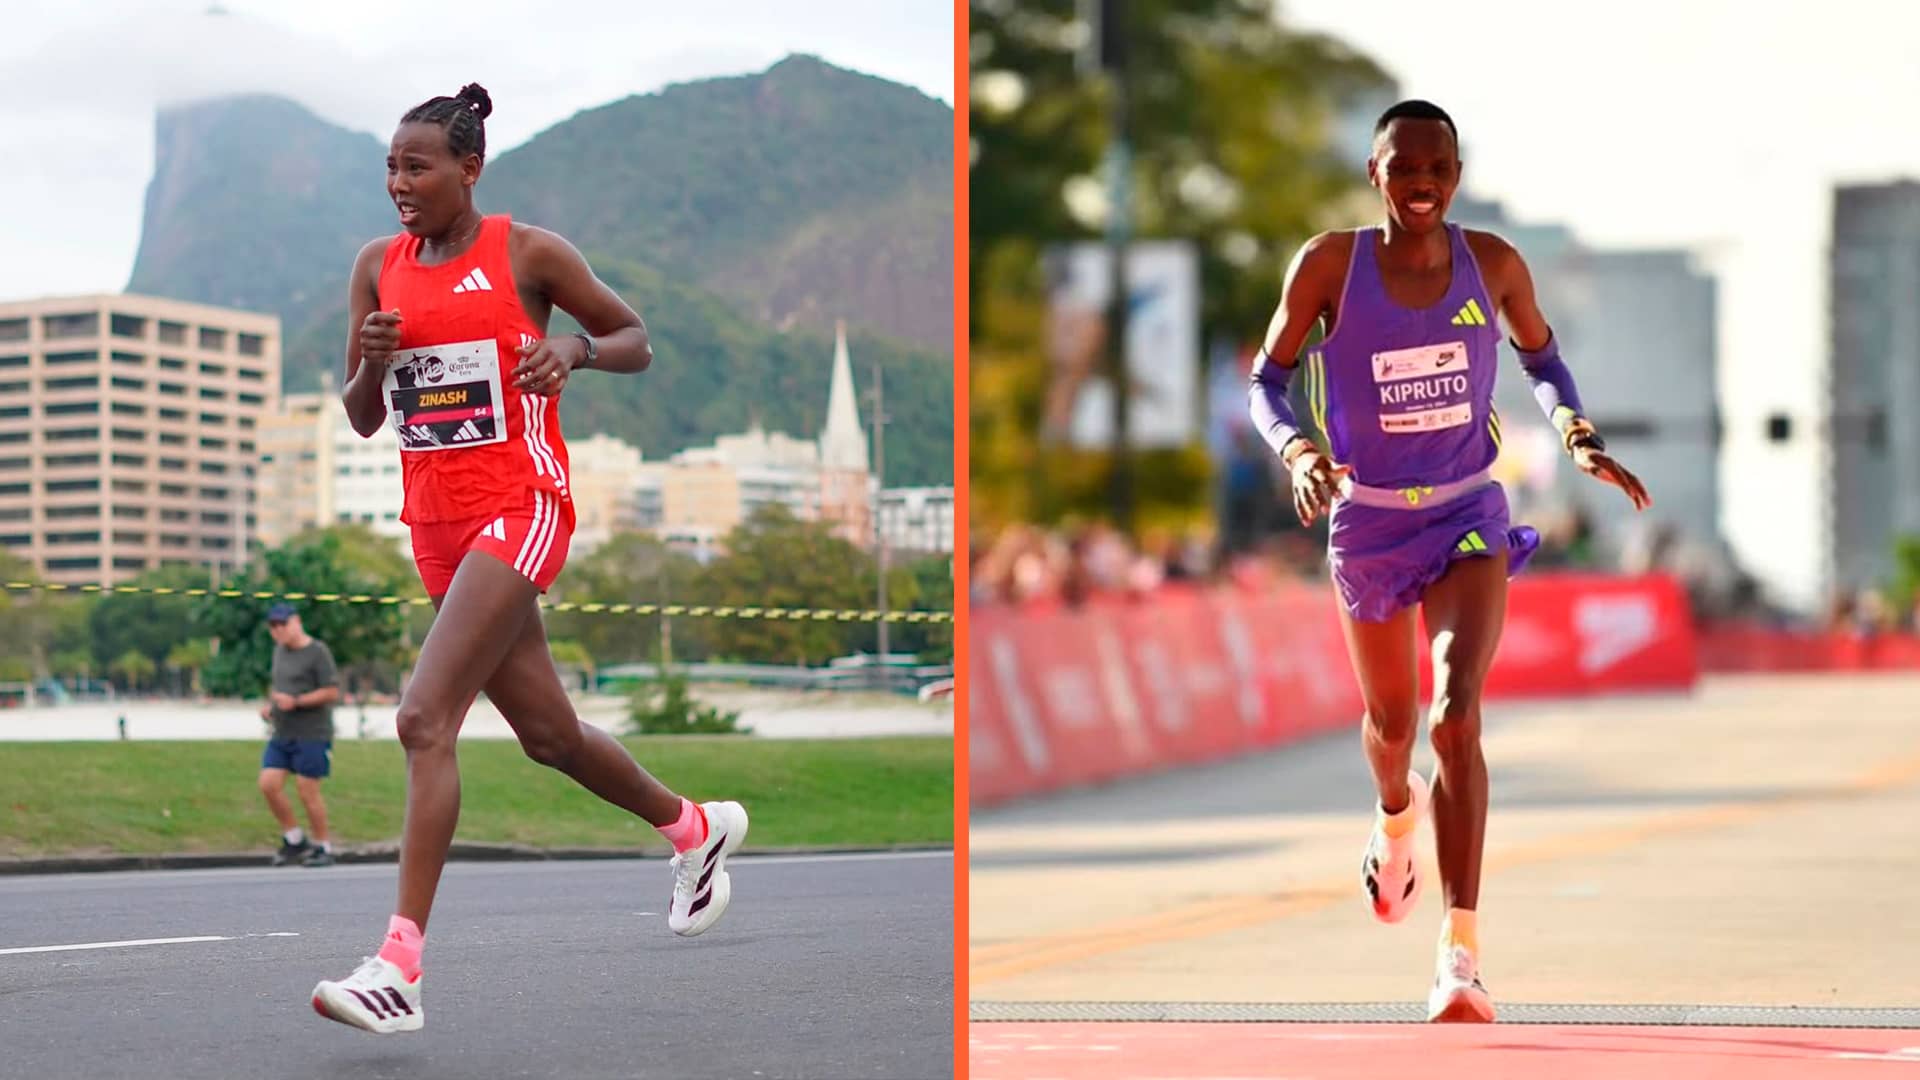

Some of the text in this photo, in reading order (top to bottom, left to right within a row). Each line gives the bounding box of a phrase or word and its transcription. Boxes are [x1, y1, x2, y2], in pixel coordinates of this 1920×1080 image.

[448, 362, 480, 373] Corona
[419, 390, 467, 408] ZINASH
[1379, 375, 1467, 405] KIPRUTO
